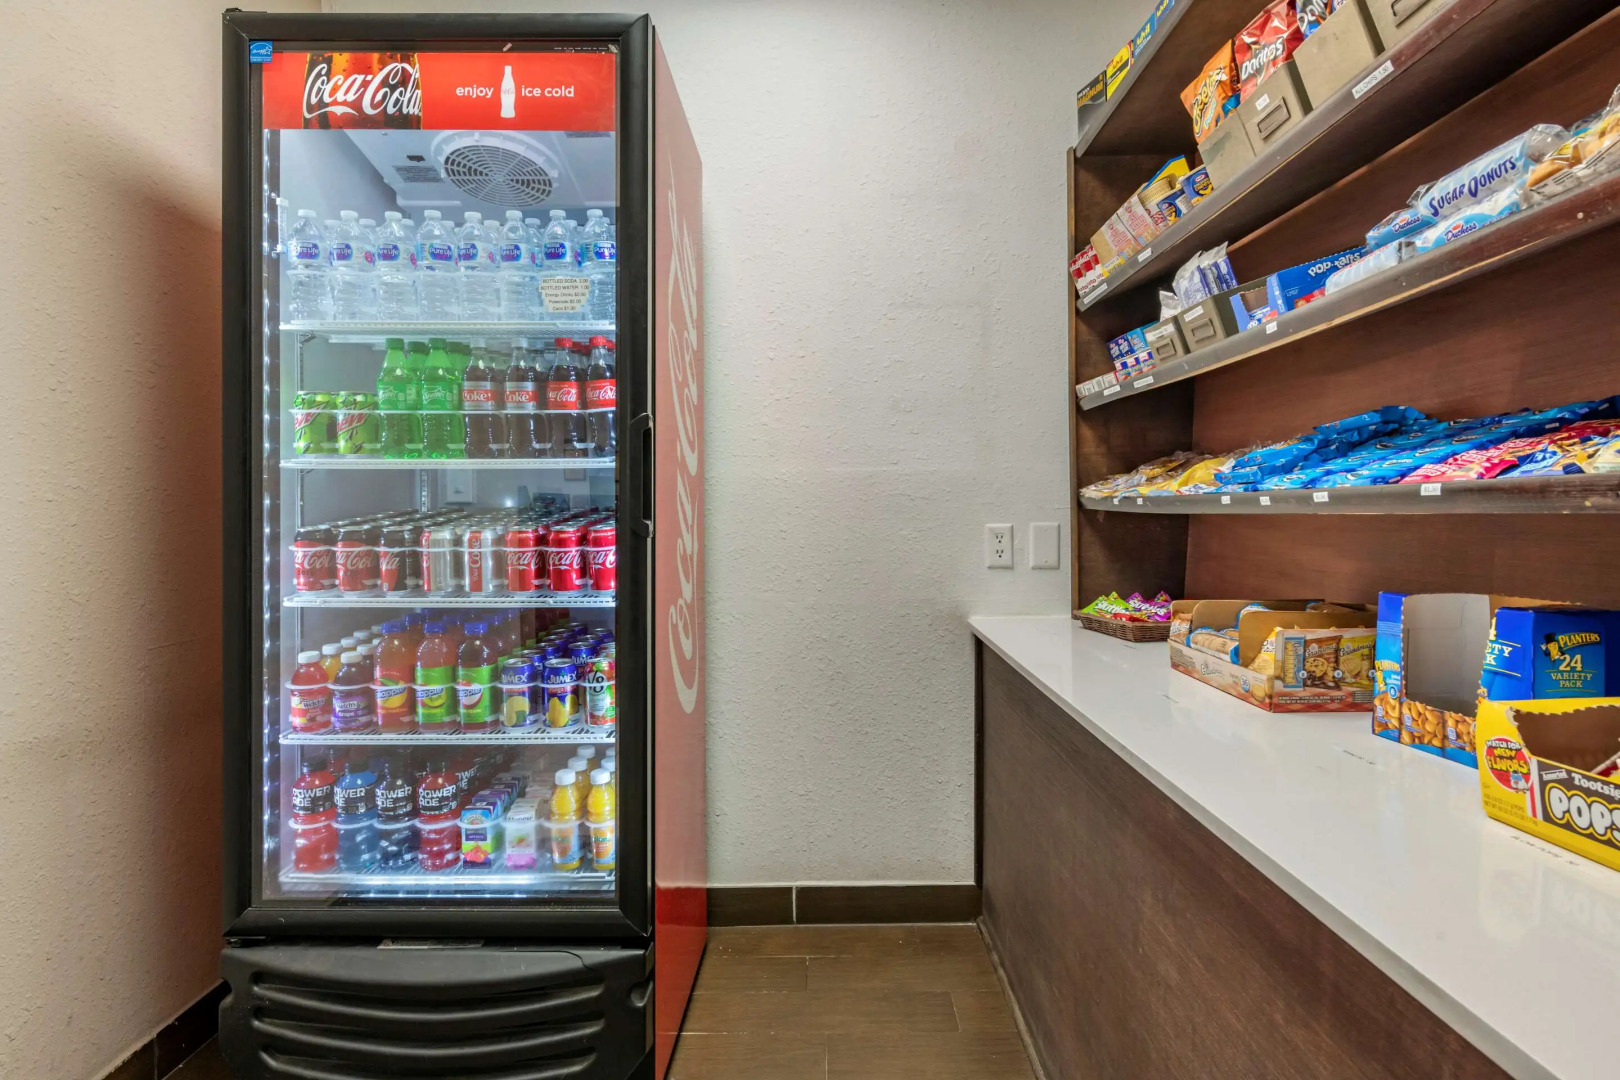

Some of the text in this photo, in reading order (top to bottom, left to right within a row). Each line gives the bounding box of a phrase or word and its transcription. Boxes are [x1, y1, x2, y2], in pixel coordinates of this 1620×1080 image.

[1241, 36, 1284, 81] Doritos
[302, 62, 422, 119] Coca-Cola
[456, 85, 494, 100] enjoy
[521, 84, 542, 98] ice
[544, 84, 575, 98] cold
[1428, 183, 1465, 218] SUGAR
[1467, 155, 1517, 199] DONUTS
[1392, 214, 1421, 234] Duchess
[1444, 221, 1478, 242] Duchess
[462, 391, 488, 402] Coke
[504, 391, 530, 402] Coke
[668, 148, 700, 714] Coca-Cola
[469, 539, 481, 568] Coke
[1557, 632, 1601, 648] PLANTERS
[1559, 654, 1583, 671] 24
[547, 671, 577, 684] JUMEX
[1550, 672, 1593, 681] VARIETY
[1559, 680, 1583, 688] PACK
[1485, 739, 1523, 750] WATCH FOR
[1493, 747, 1517, 759] NEW
[418, 785, 457, 799] POWER
[1571, 772, 1620, 800] Tootsie
